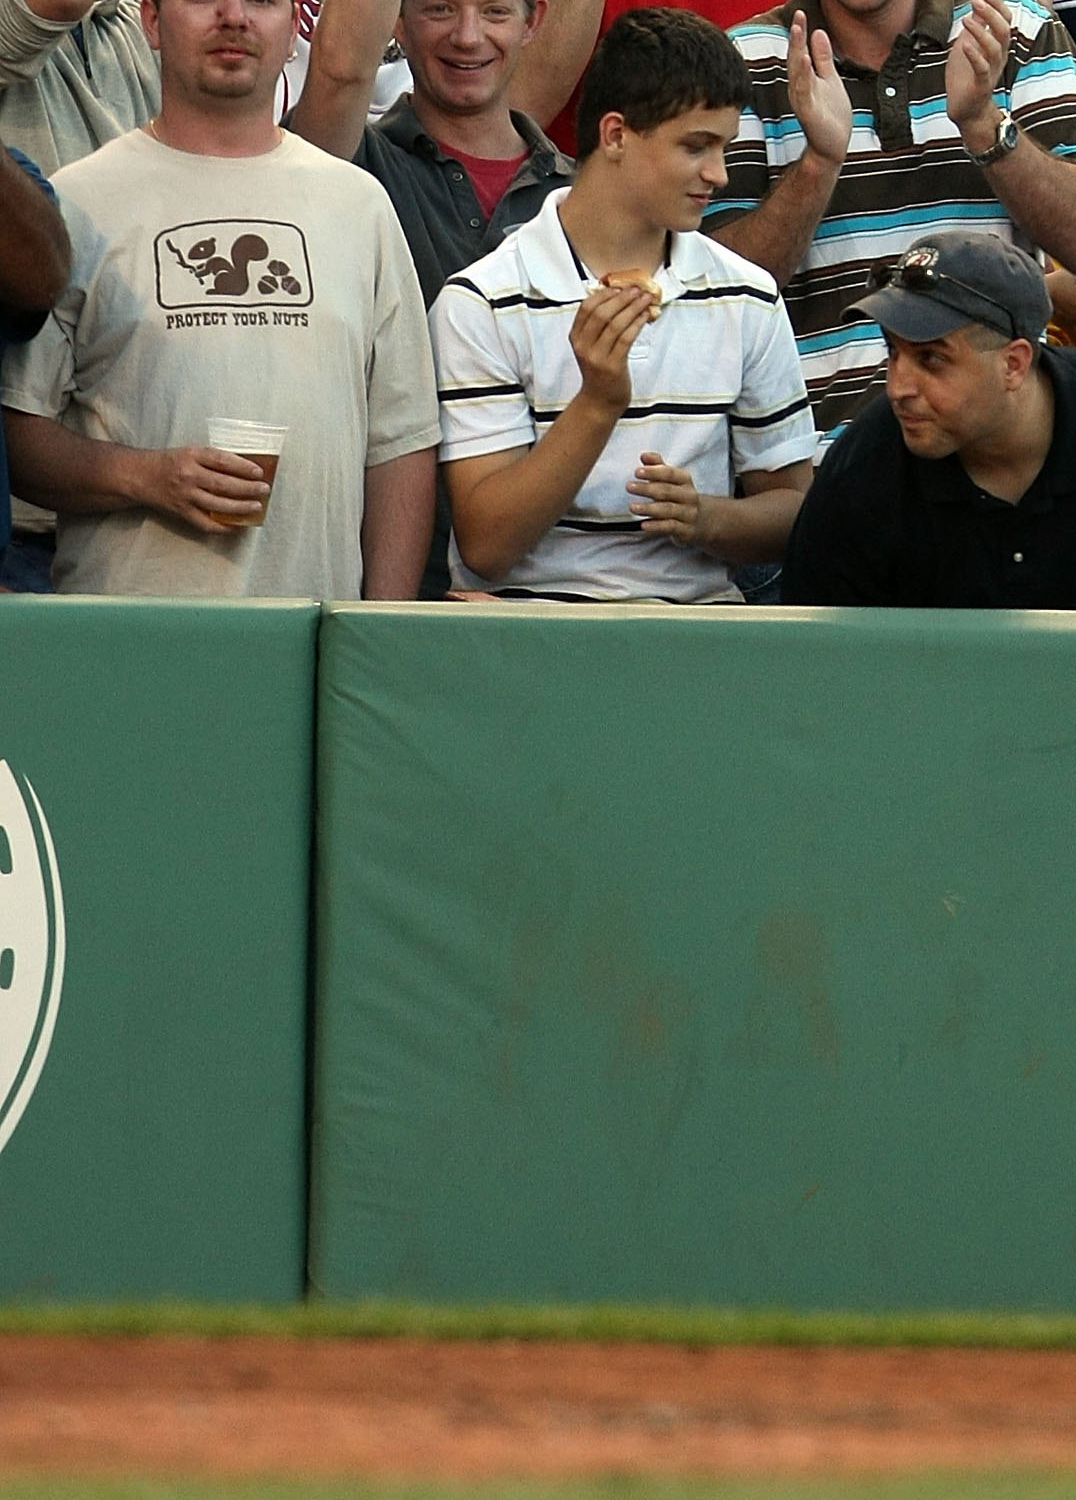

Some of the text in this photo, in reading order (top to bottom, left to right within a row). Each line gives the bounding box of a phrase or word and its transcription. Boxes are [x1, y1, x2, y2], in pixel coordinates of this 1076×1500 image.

[165, 311, 309, 330] PROTECT YOUR NUTS
